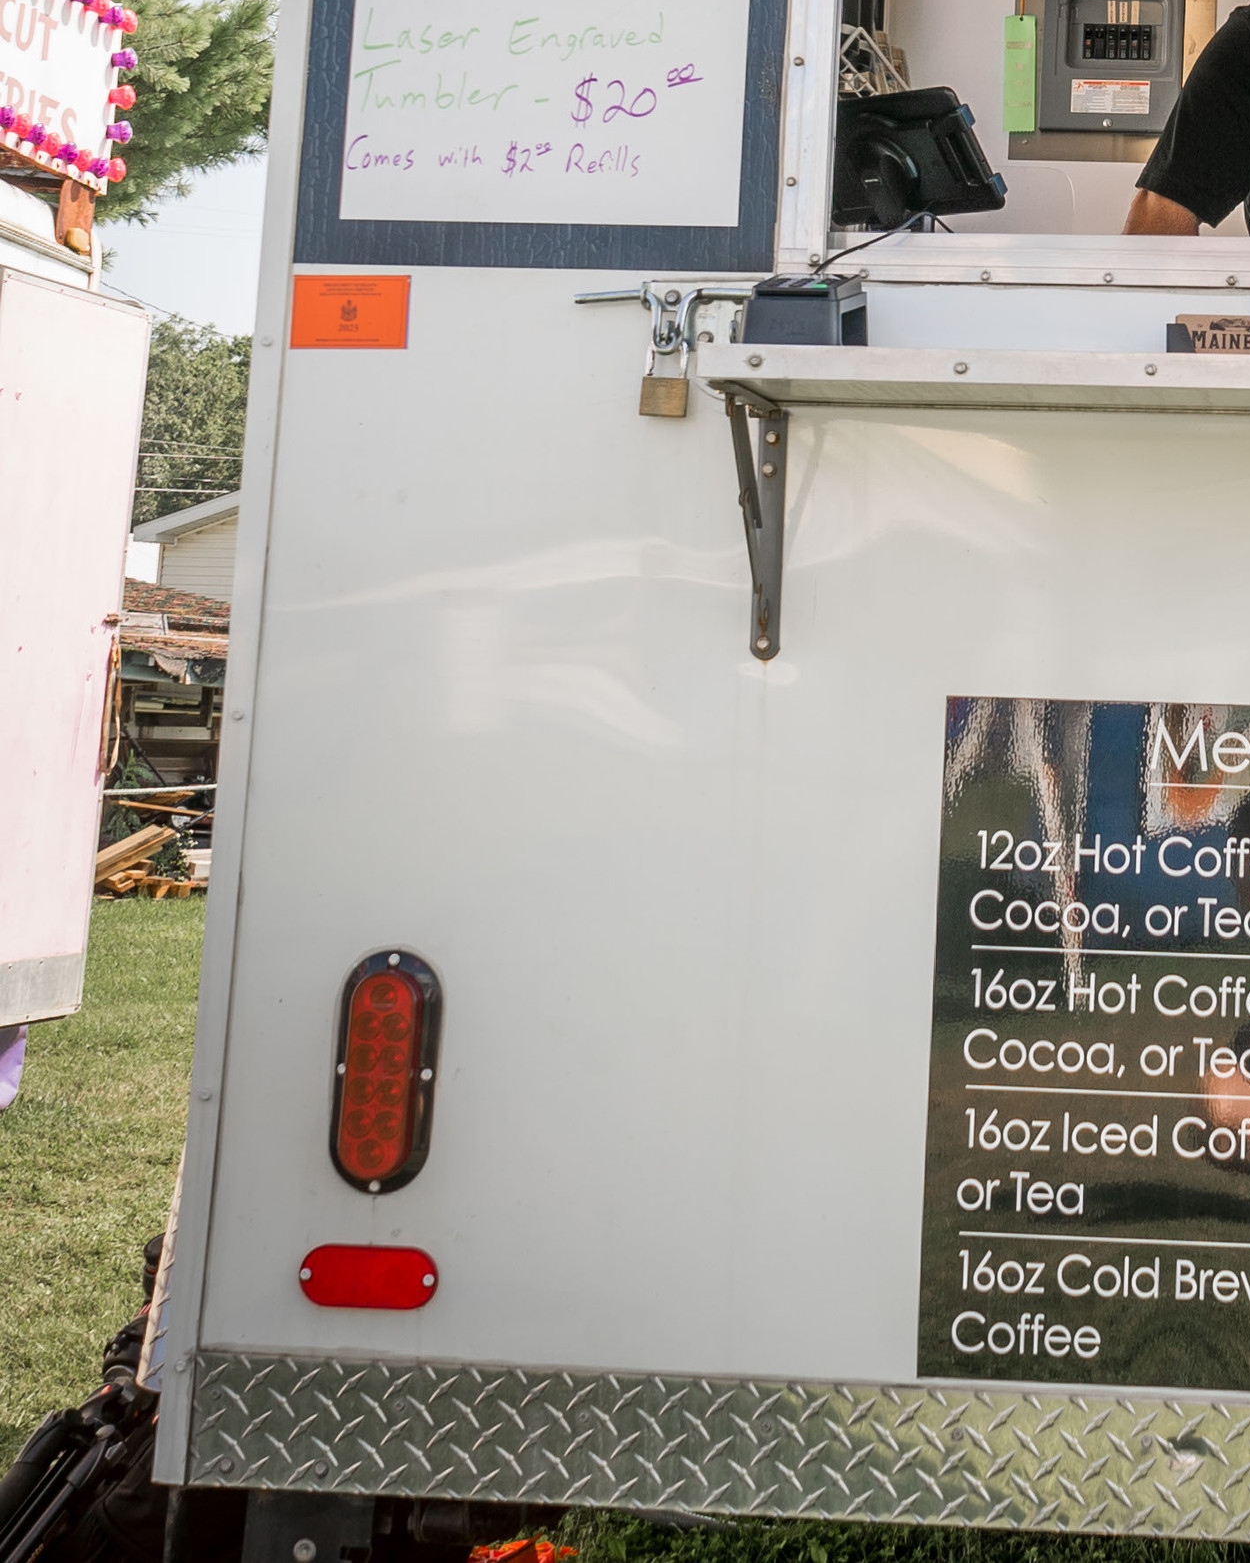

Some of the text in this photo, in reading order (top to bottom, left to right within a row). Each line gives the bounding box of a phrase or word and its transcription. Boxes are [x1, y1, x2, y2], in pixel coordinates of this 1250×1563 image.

[363, 7, 664, 61] Laser Engraved
[0, 70, 77, 144] RIES
[354, 60, 518, 113] Tumbler
[346, 135, 415, 171] Comes
[438, 147, 483, 166] with
[565, 143, 642, 178] Refills
[977, 829, 1061, 871] 12oz
[1074, 833, 1146, 875] Hot
[969, 889, 1131, 938] Cocoa,
[1145, 904, 1188, 937] or
[971, 967, 1056, 1011] 16oz
[1068, 972, 1142, 1014] Hot
[963, 1028, 1126, 1078] Cocoa,
[1140, 1044, 1183, 1077] or
[965, 1107, 1051, 1152] 16oz
[1063, 1111, 1158, 1157] Iced
[956, 1171, 1084, 1215] or Tea
[959, 1249, 1045, 1294] 16oz
[1057, 1253, 1160, 1300] Cold
[951, 1311, 1101, 1359] Coffee
